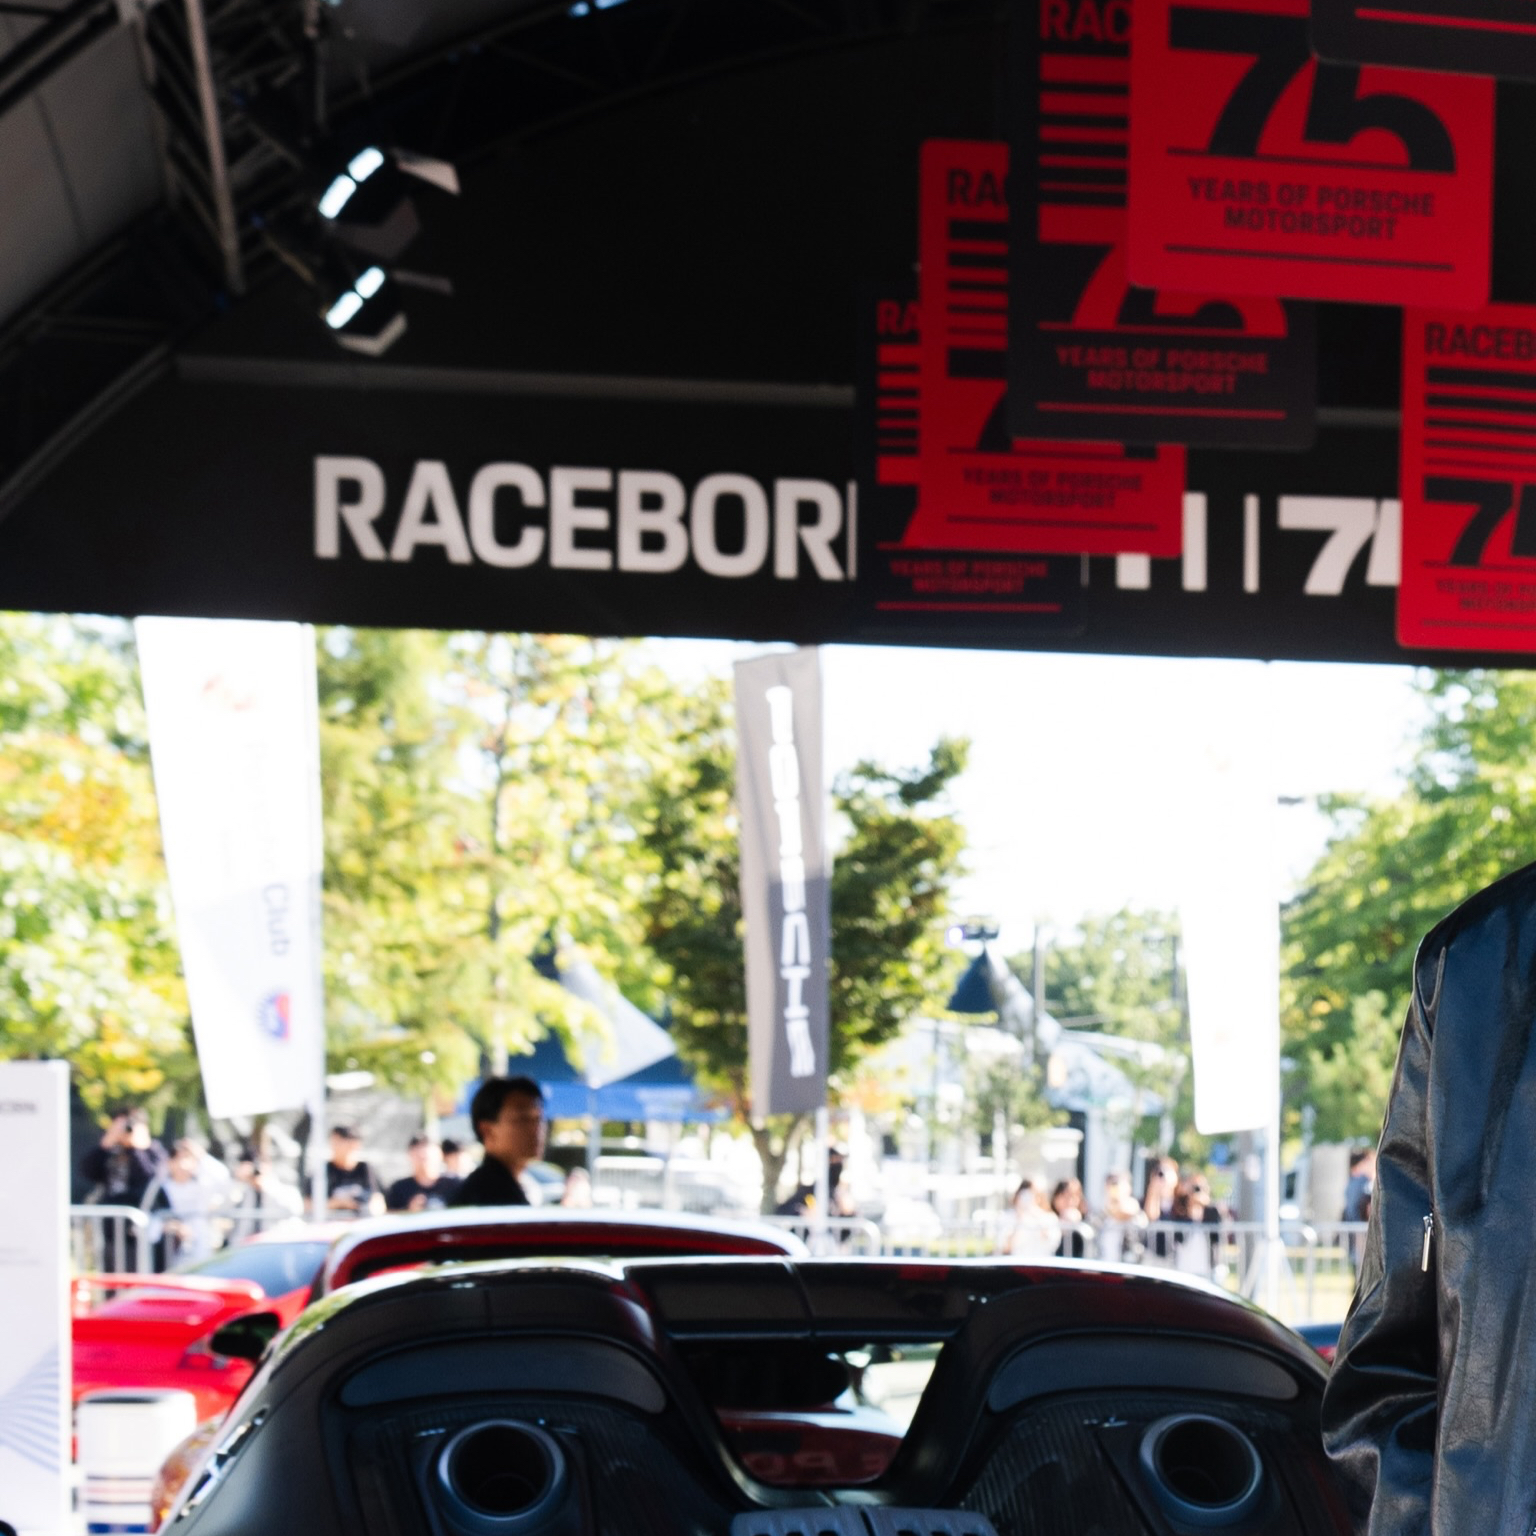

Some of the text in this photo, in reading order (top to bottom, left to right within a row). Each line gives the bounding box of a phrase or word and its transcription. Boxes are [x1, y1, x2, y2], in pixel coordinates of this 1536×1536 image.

[1168, 7, 1457, 175] 75
[946, 169, 1008, 206] RA
[1187, 177, 1436, 218] YEARS OF PORSCHE
[1223, 206, 1399, 240] MOTORSPORT
[1056, 345, 1269, 374] YEARS OF PORSCHE
[1087, 370, 1238, 393] MOTORSPORT
[1056, 472, 1142, 492] PORSCHE
[314, 455, 857, 582] RACEBOR
[261, 882, 292, 957] Club
